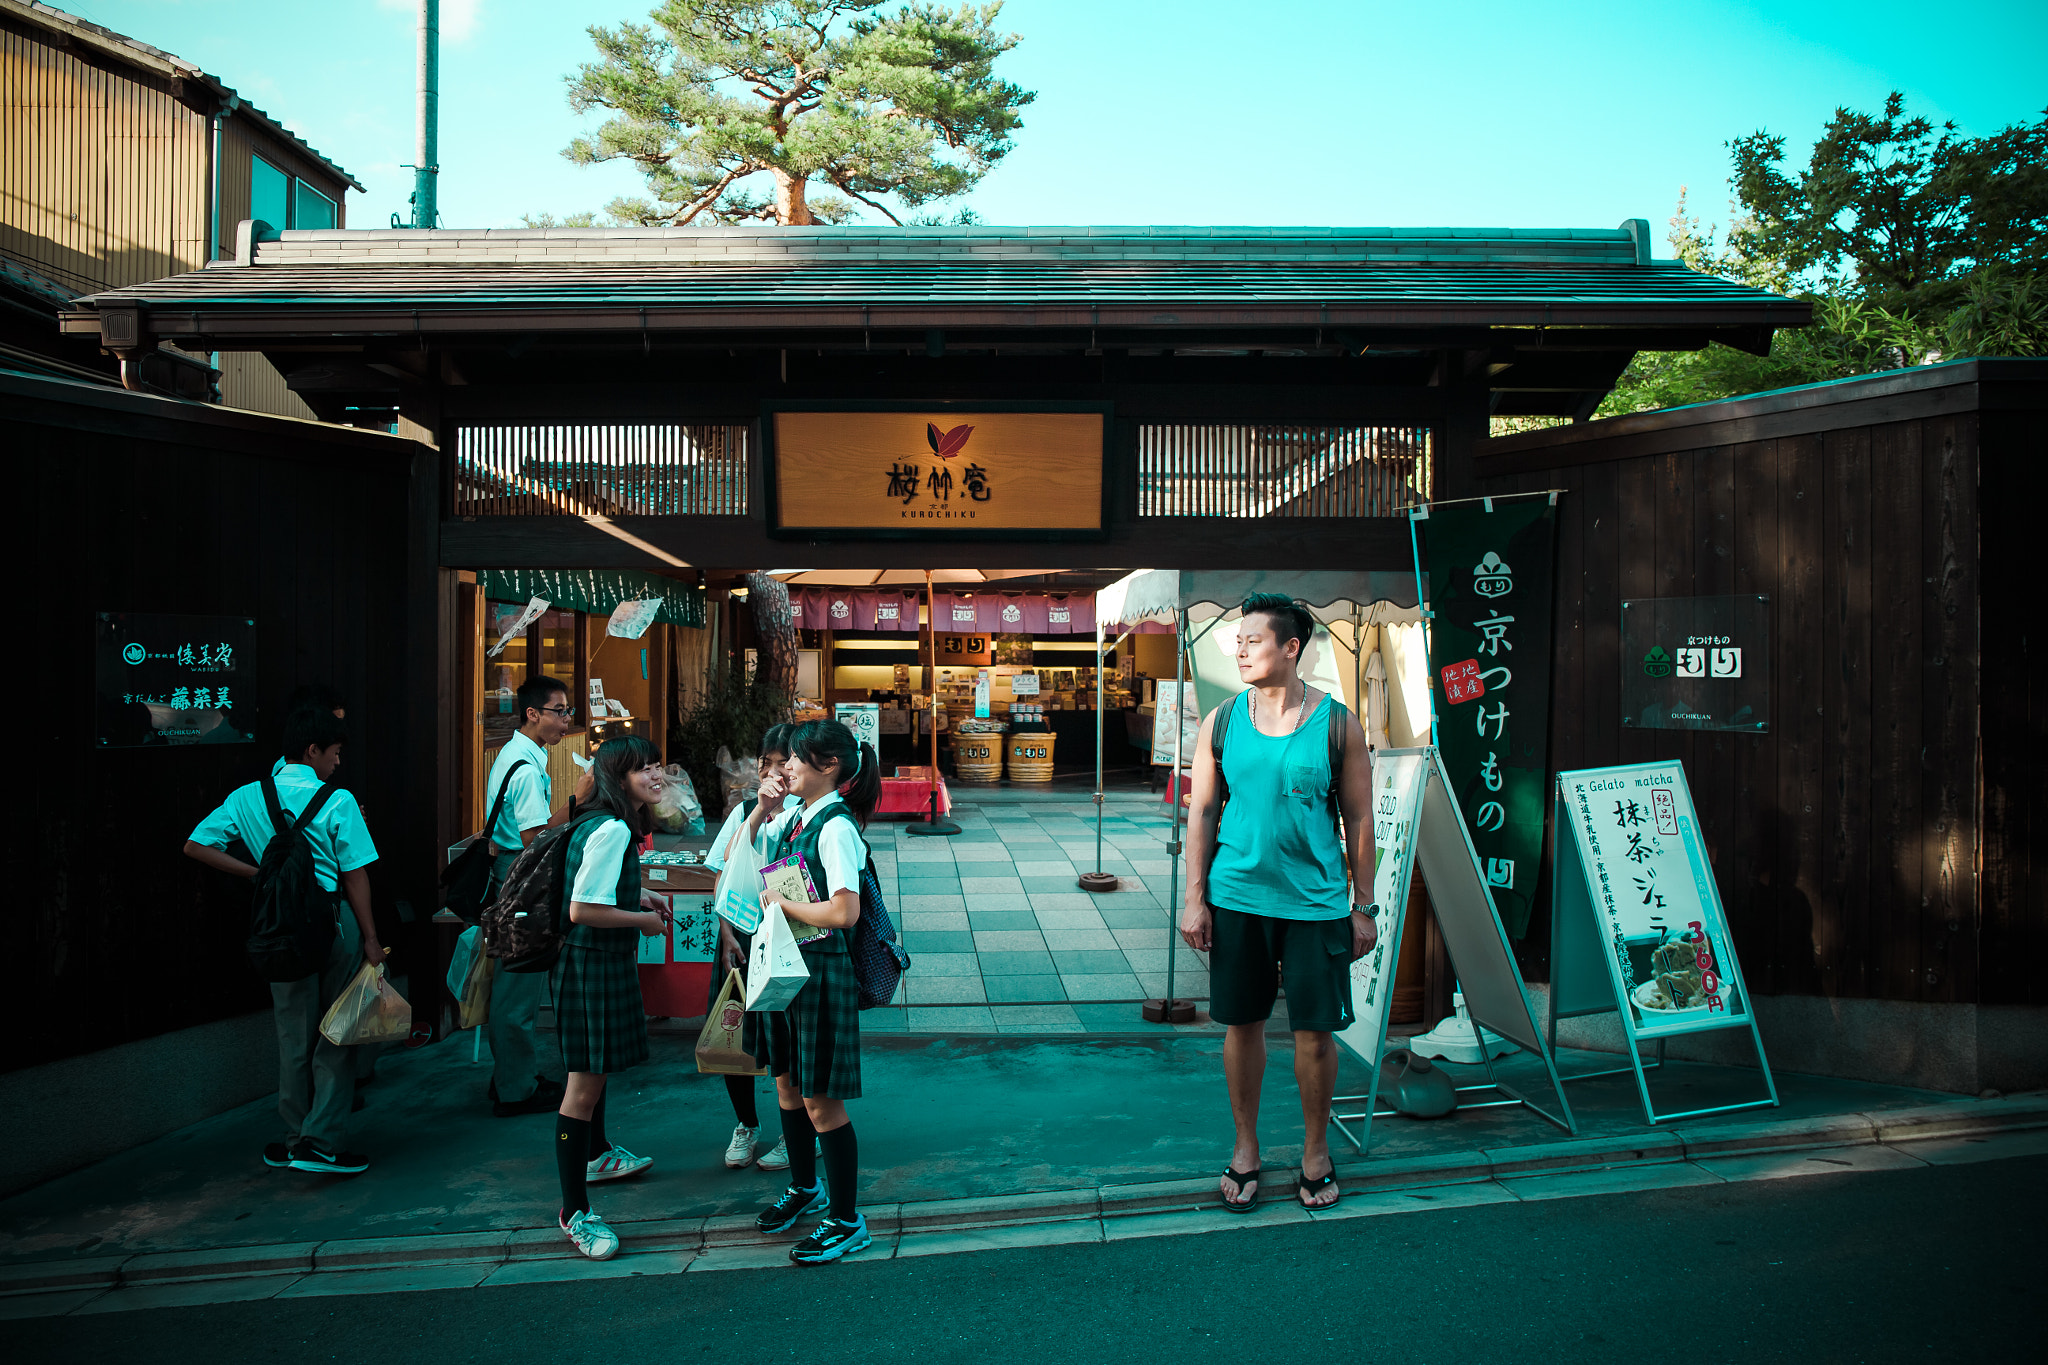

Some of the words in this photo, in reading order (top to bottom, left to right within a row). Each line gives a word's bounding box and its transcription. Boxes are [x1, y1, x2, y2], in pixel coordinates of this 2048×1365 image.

[885, 462, 992, 504] 桜竹庵
[901, 510, 976, 519] KUROCHIKU
[1480, 579, 1506, 592] もり
[945, 637, 985, 654] もり
[1687, 635, 1731, 646] 京つけもの
[1676, 647, 1742, 678] もり
[1462, 664, 1479, 694] 地産
[122, 693, 168, 705] 京だんご
[170, 686, 234, 711] 藤菜美
[1473, 609, 1515, 832] 京つけもの
[1671, 712, 1712, 721] OUCHIKUAN
[157, 729, 201, 737] OUCHIKUAN
[1589, 780, 1625, 792] Gelato
[1634, 774, 1674, 788] matcha
[1378, 795, 1397, 816] SOLD
[1376, 820, 1394, 842] OUT
[1478, 857, 1515, 890] り
[1612, 798, 1685, 1012] 抹茶ジェラート
[701, 900, 716, 956] 甘み抹茶
[1687, 920, 1724, 1014] 360円
